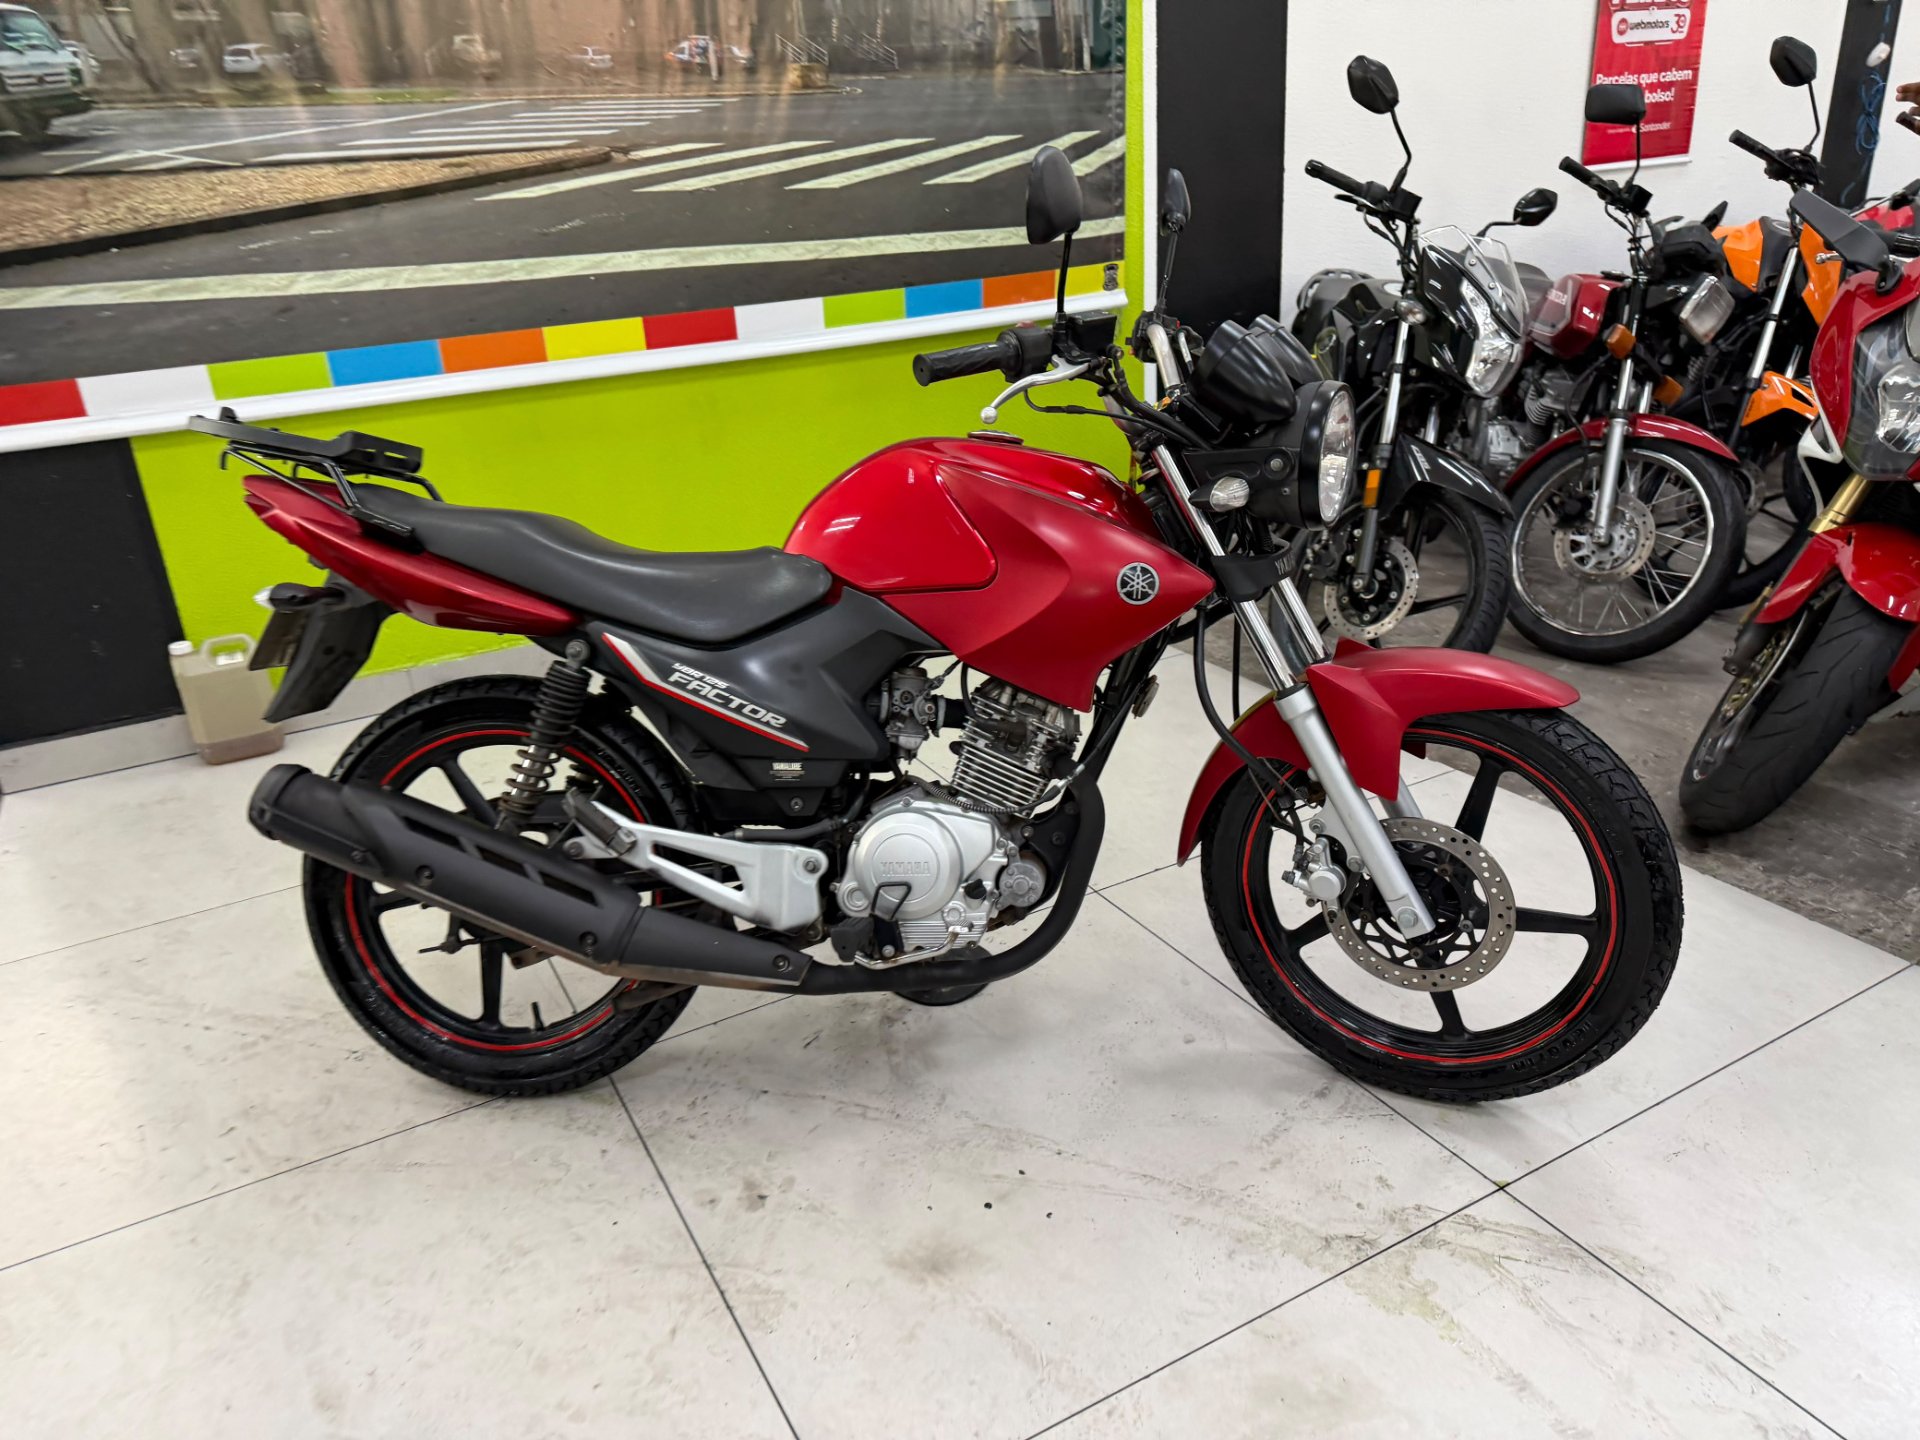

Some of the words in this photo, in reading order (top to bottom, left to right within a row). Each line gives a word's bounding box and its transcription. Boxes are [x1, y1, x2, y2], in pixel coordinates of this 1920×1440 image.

[1629, 19, 1670, 31] webmotors
[1596, 72, 1638, 84] Parcelas
[1640, 72, 1658, 87] que
[1660, 68, 1693, 82] cabem
[1644, 87, 1675, 104] bolso!
[1639, 122, 1672, 133] Santander
[667, 671, 788, 728] FACTOR
[880, 861, 930, 877] YAMAHA
